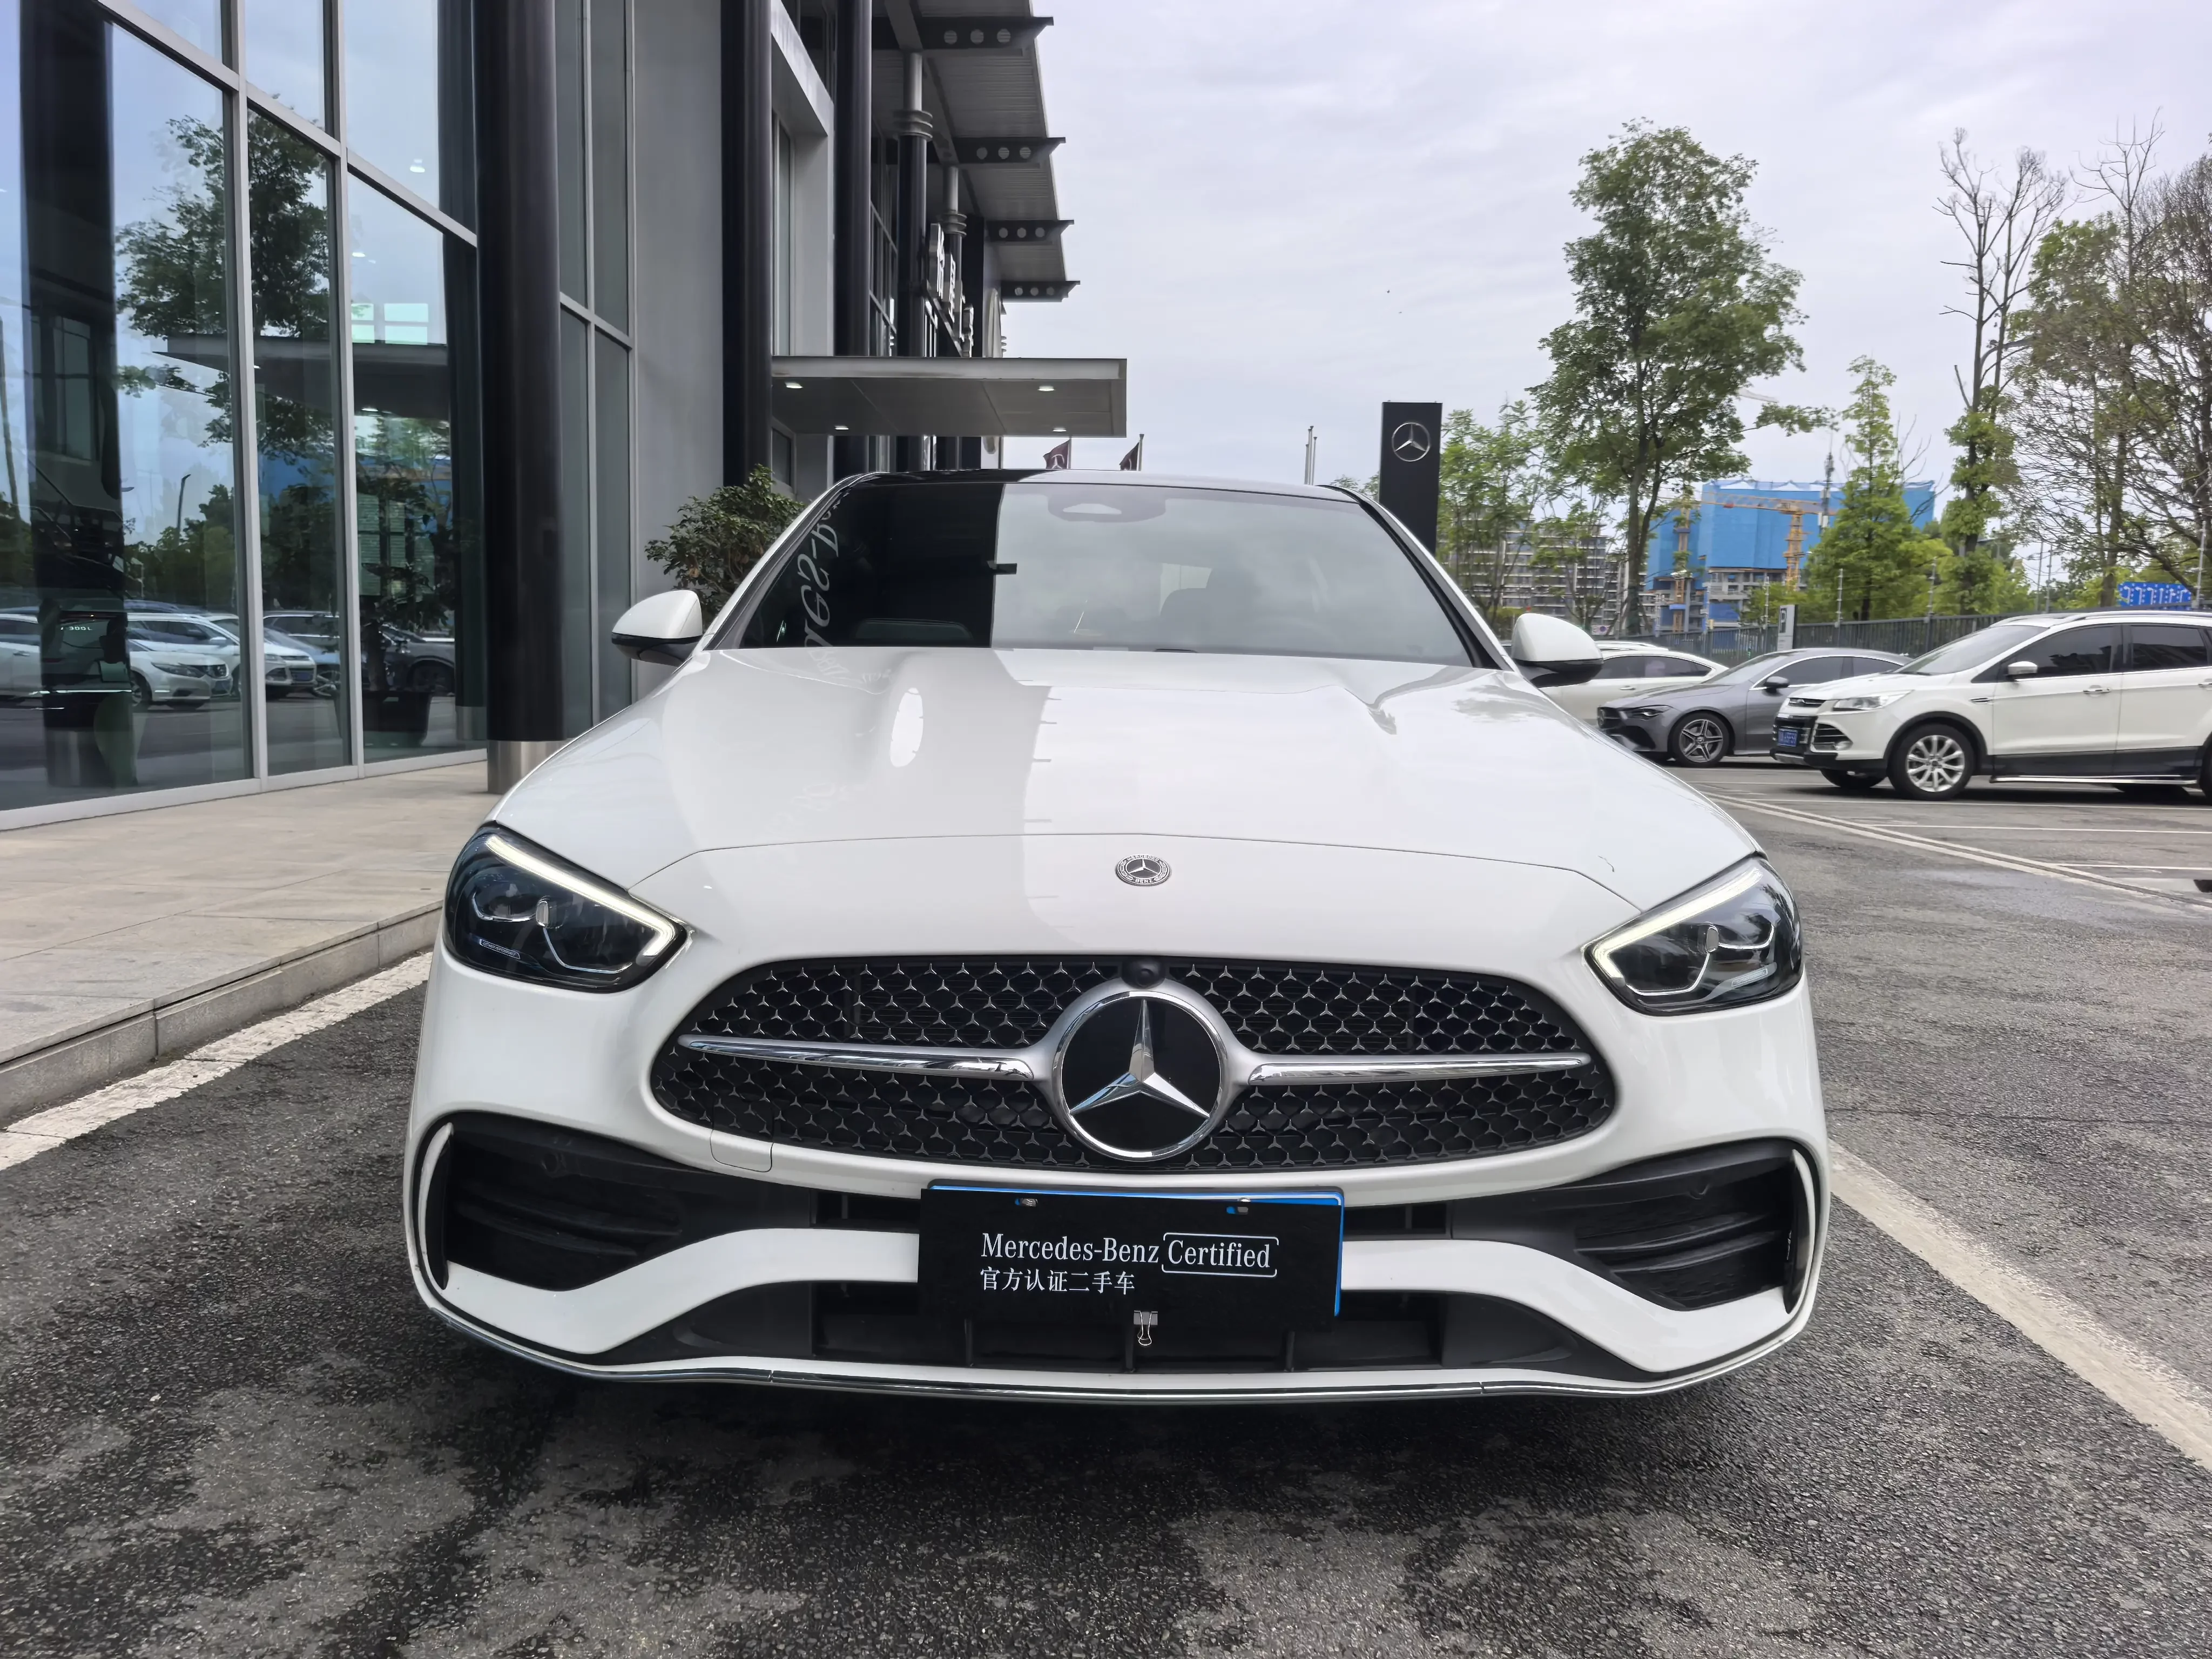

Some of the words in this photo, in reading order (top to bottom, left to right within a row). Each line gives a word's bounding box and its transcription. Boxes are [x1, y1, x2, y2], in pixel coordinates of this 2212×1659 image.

[981, 1233, 1159, 1263] Mercedes-Benz
[1168, 1240, 1270, 1268] Certified
[980, 1266, 1135, 1295] 官方认证二手车
